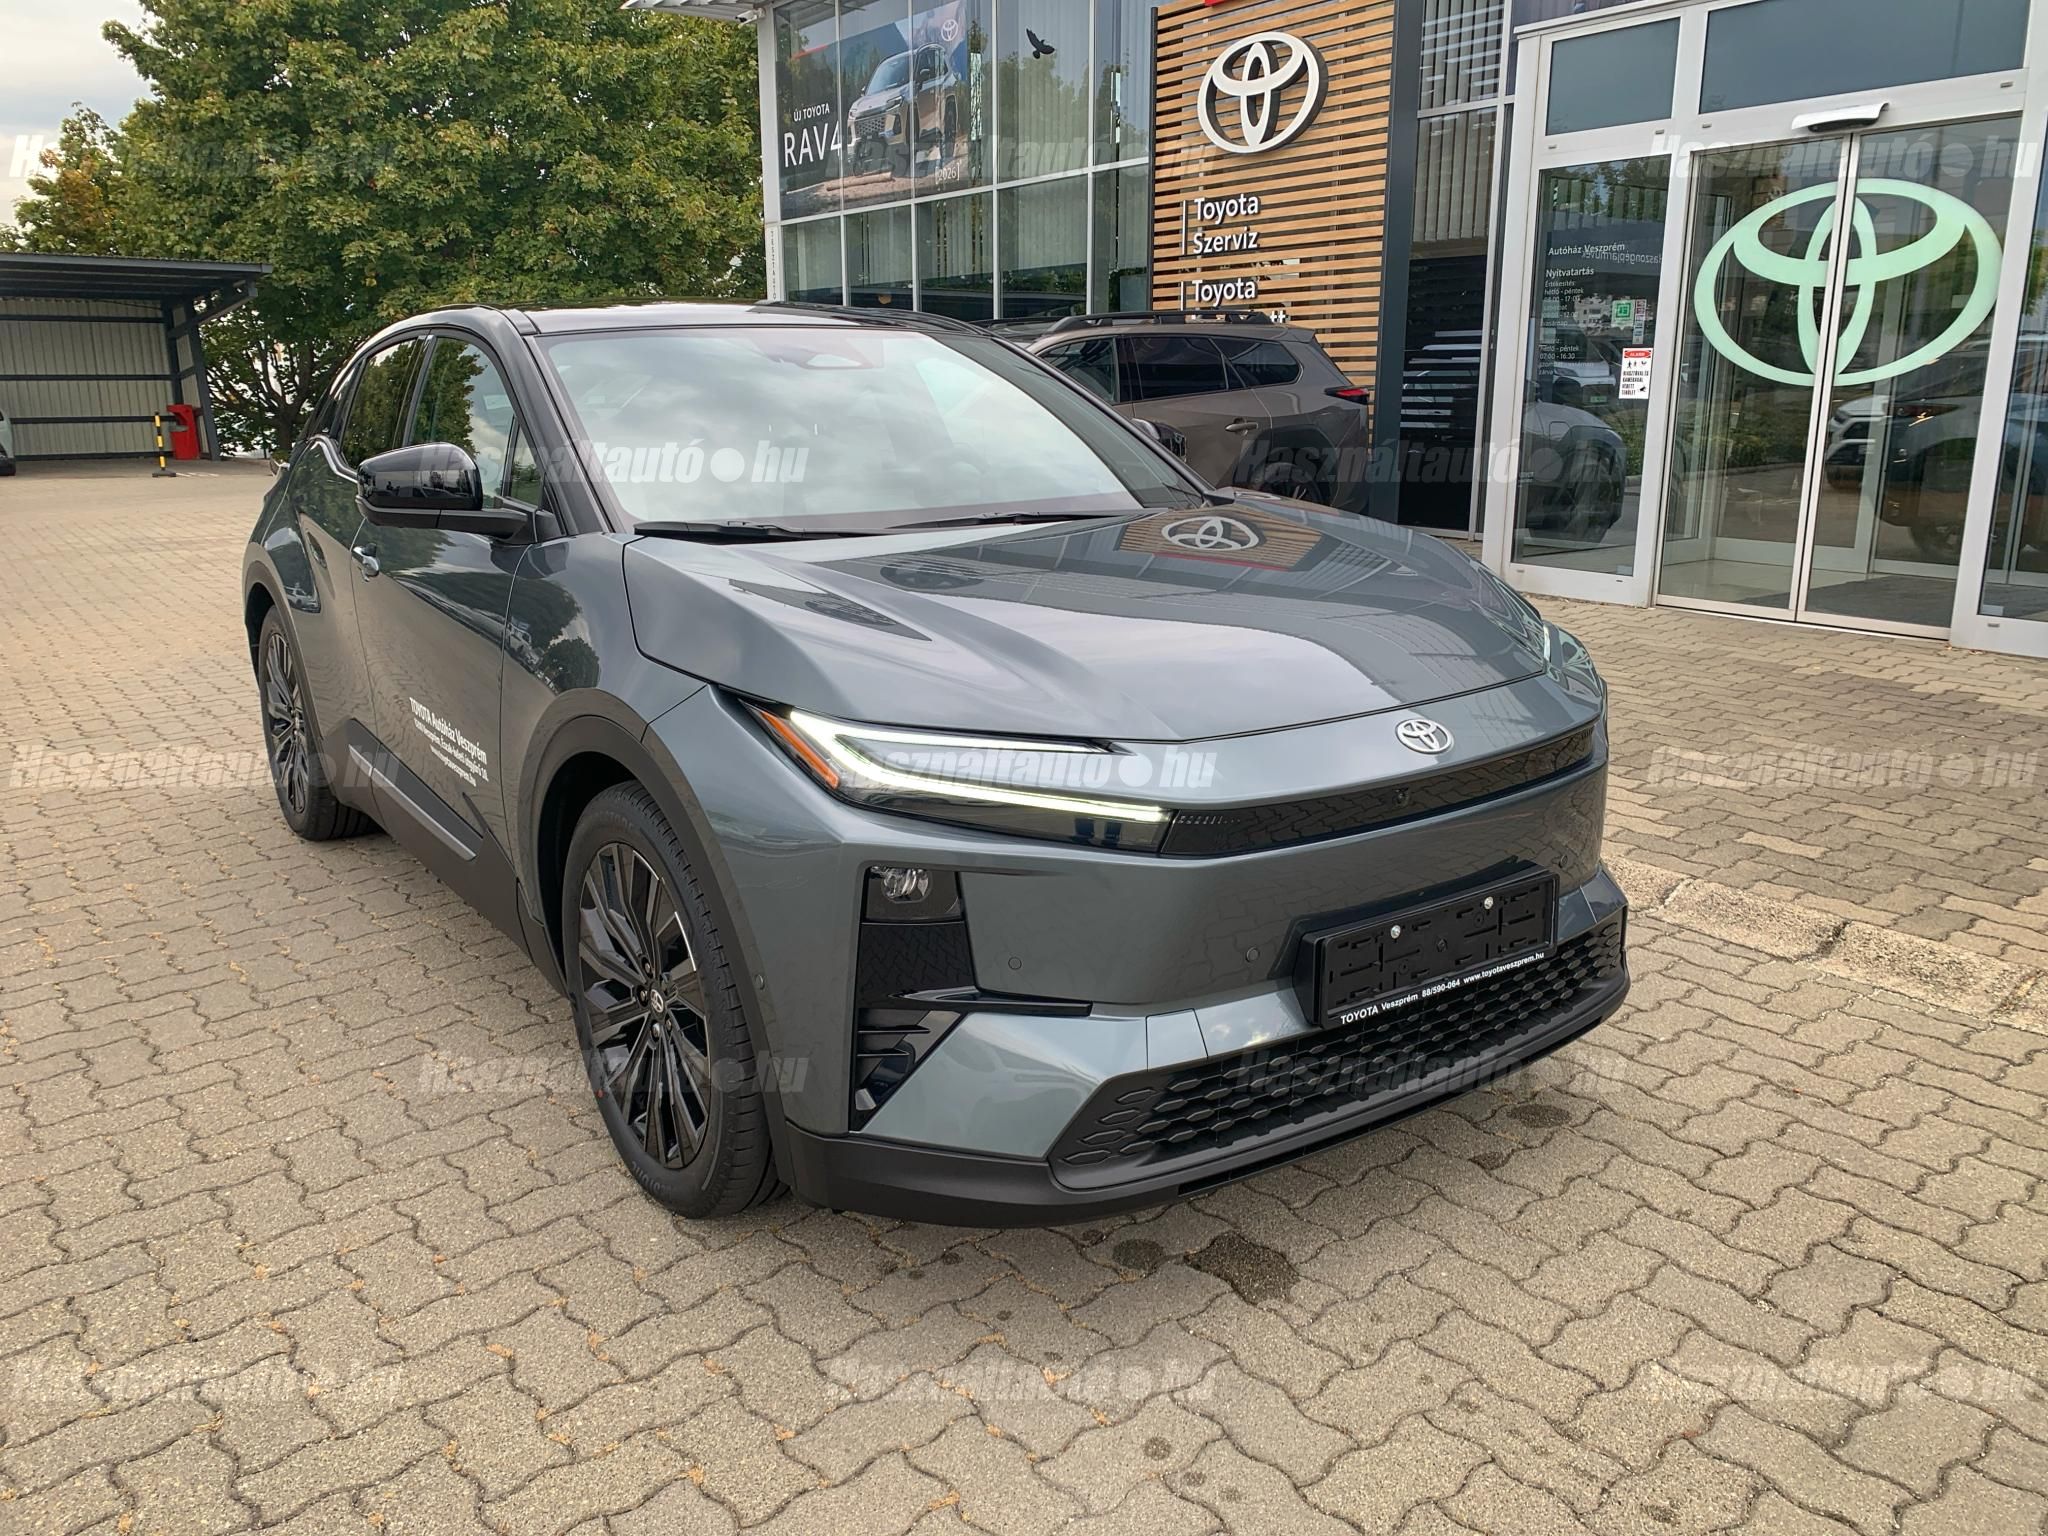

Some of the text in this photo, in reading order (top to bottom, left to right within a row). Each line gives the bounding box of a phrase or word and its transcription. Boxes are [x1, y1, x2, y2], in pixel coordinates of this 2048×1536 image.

[802, 103, 830, 119] TOYOTA
[784, 121, 842, 168] RAV4
[1194, 193, 1258, 225] Toyota
[1193, 226, 1258, 254] Szerviz
[1548, 242, 1625, 256] Autóház Veszprém
[1545, 267, 1595, 279] Nyitvatartás
[1191, 278, 1256, 307] Toyota
[454, 727, 488, 766] Veszprém
[1340, 951, 1545, 1025] TOYOTA Veszprém 88/590-064 www.toyotaveszprem.hu
